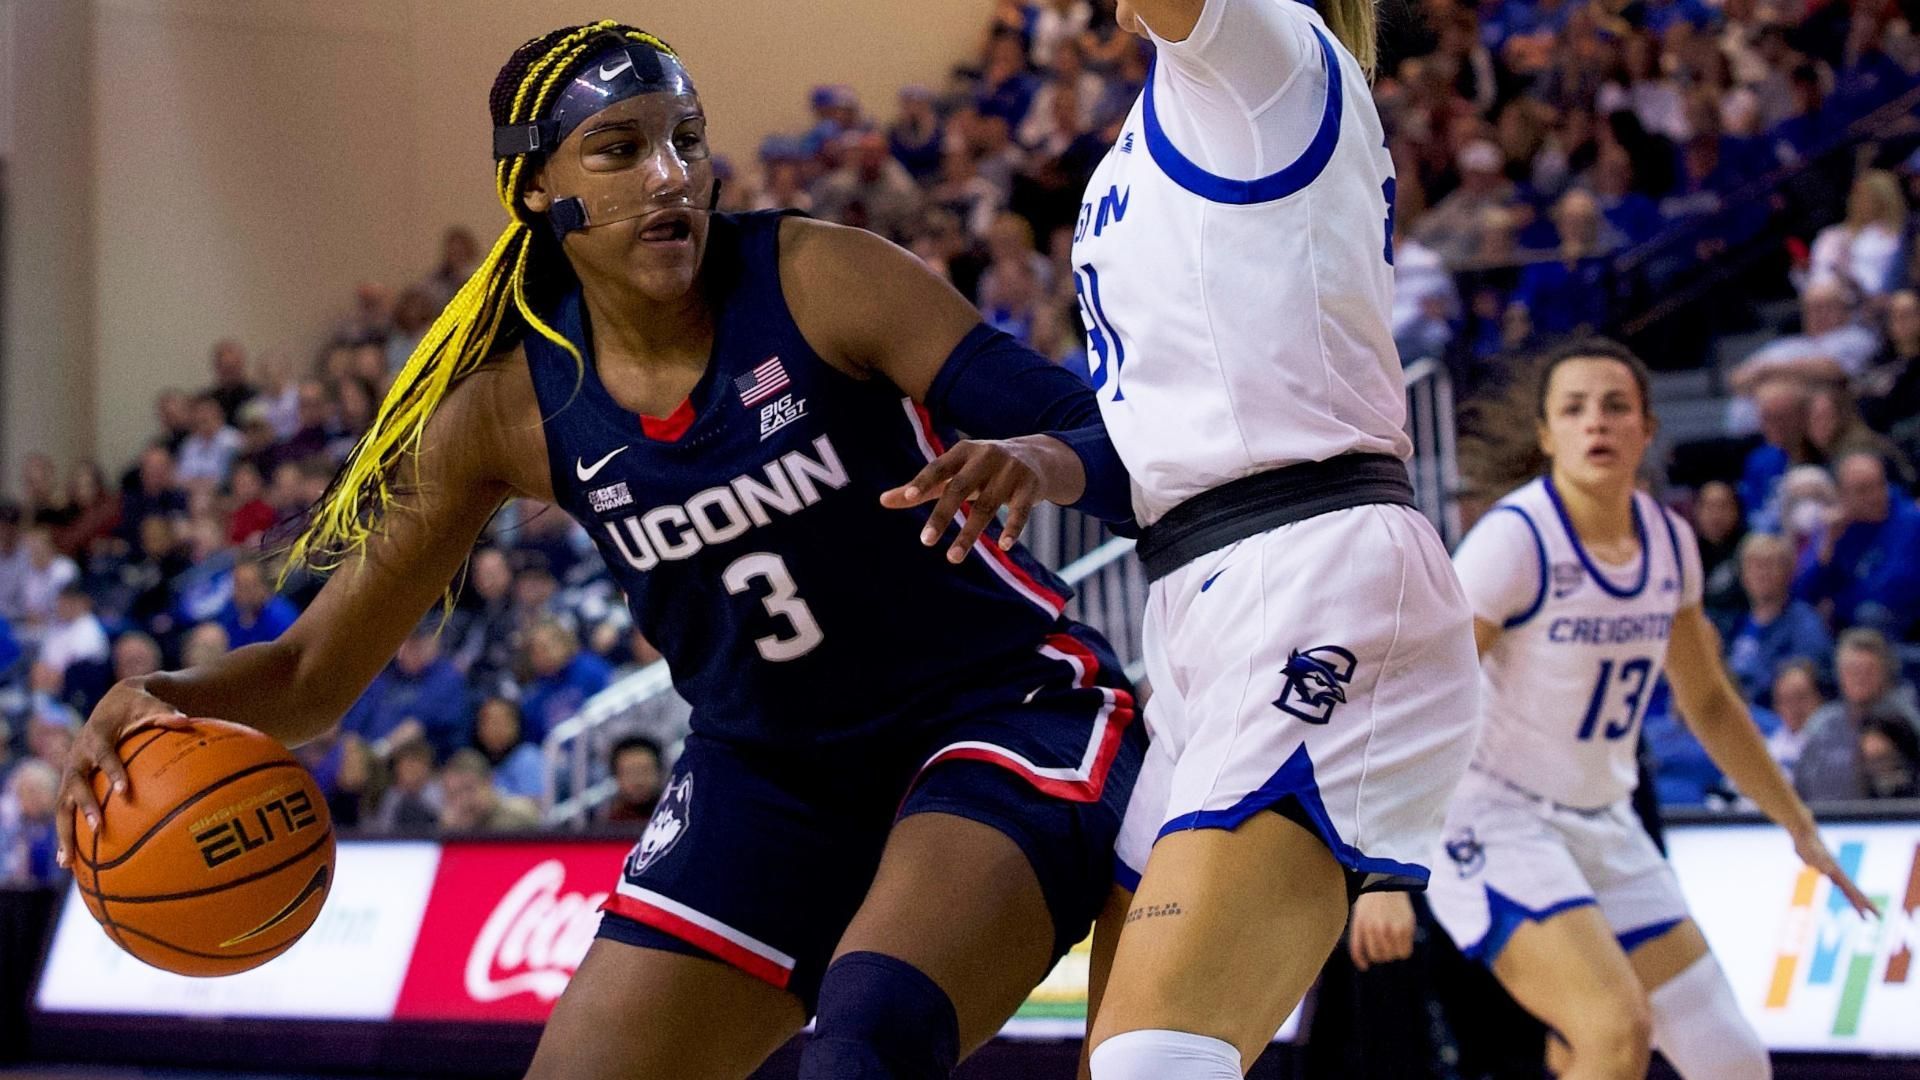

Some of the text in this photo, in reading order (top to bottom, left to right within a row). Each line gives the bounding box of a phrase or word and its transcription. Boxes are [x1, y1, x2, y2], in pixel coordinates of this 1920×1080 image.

[760, 393, 792, 422] BIG
[760, 398, 806, 434] EAST
[593, 495, 633, 512] CHANGE
[597, 485, 618, 501] BE
[605, 433, 851, 571] UCONN
[721, 552, 825, 662] 3
[1577, 657, 1654, 741] 13
[194, 788, 318, 869] ELITE
